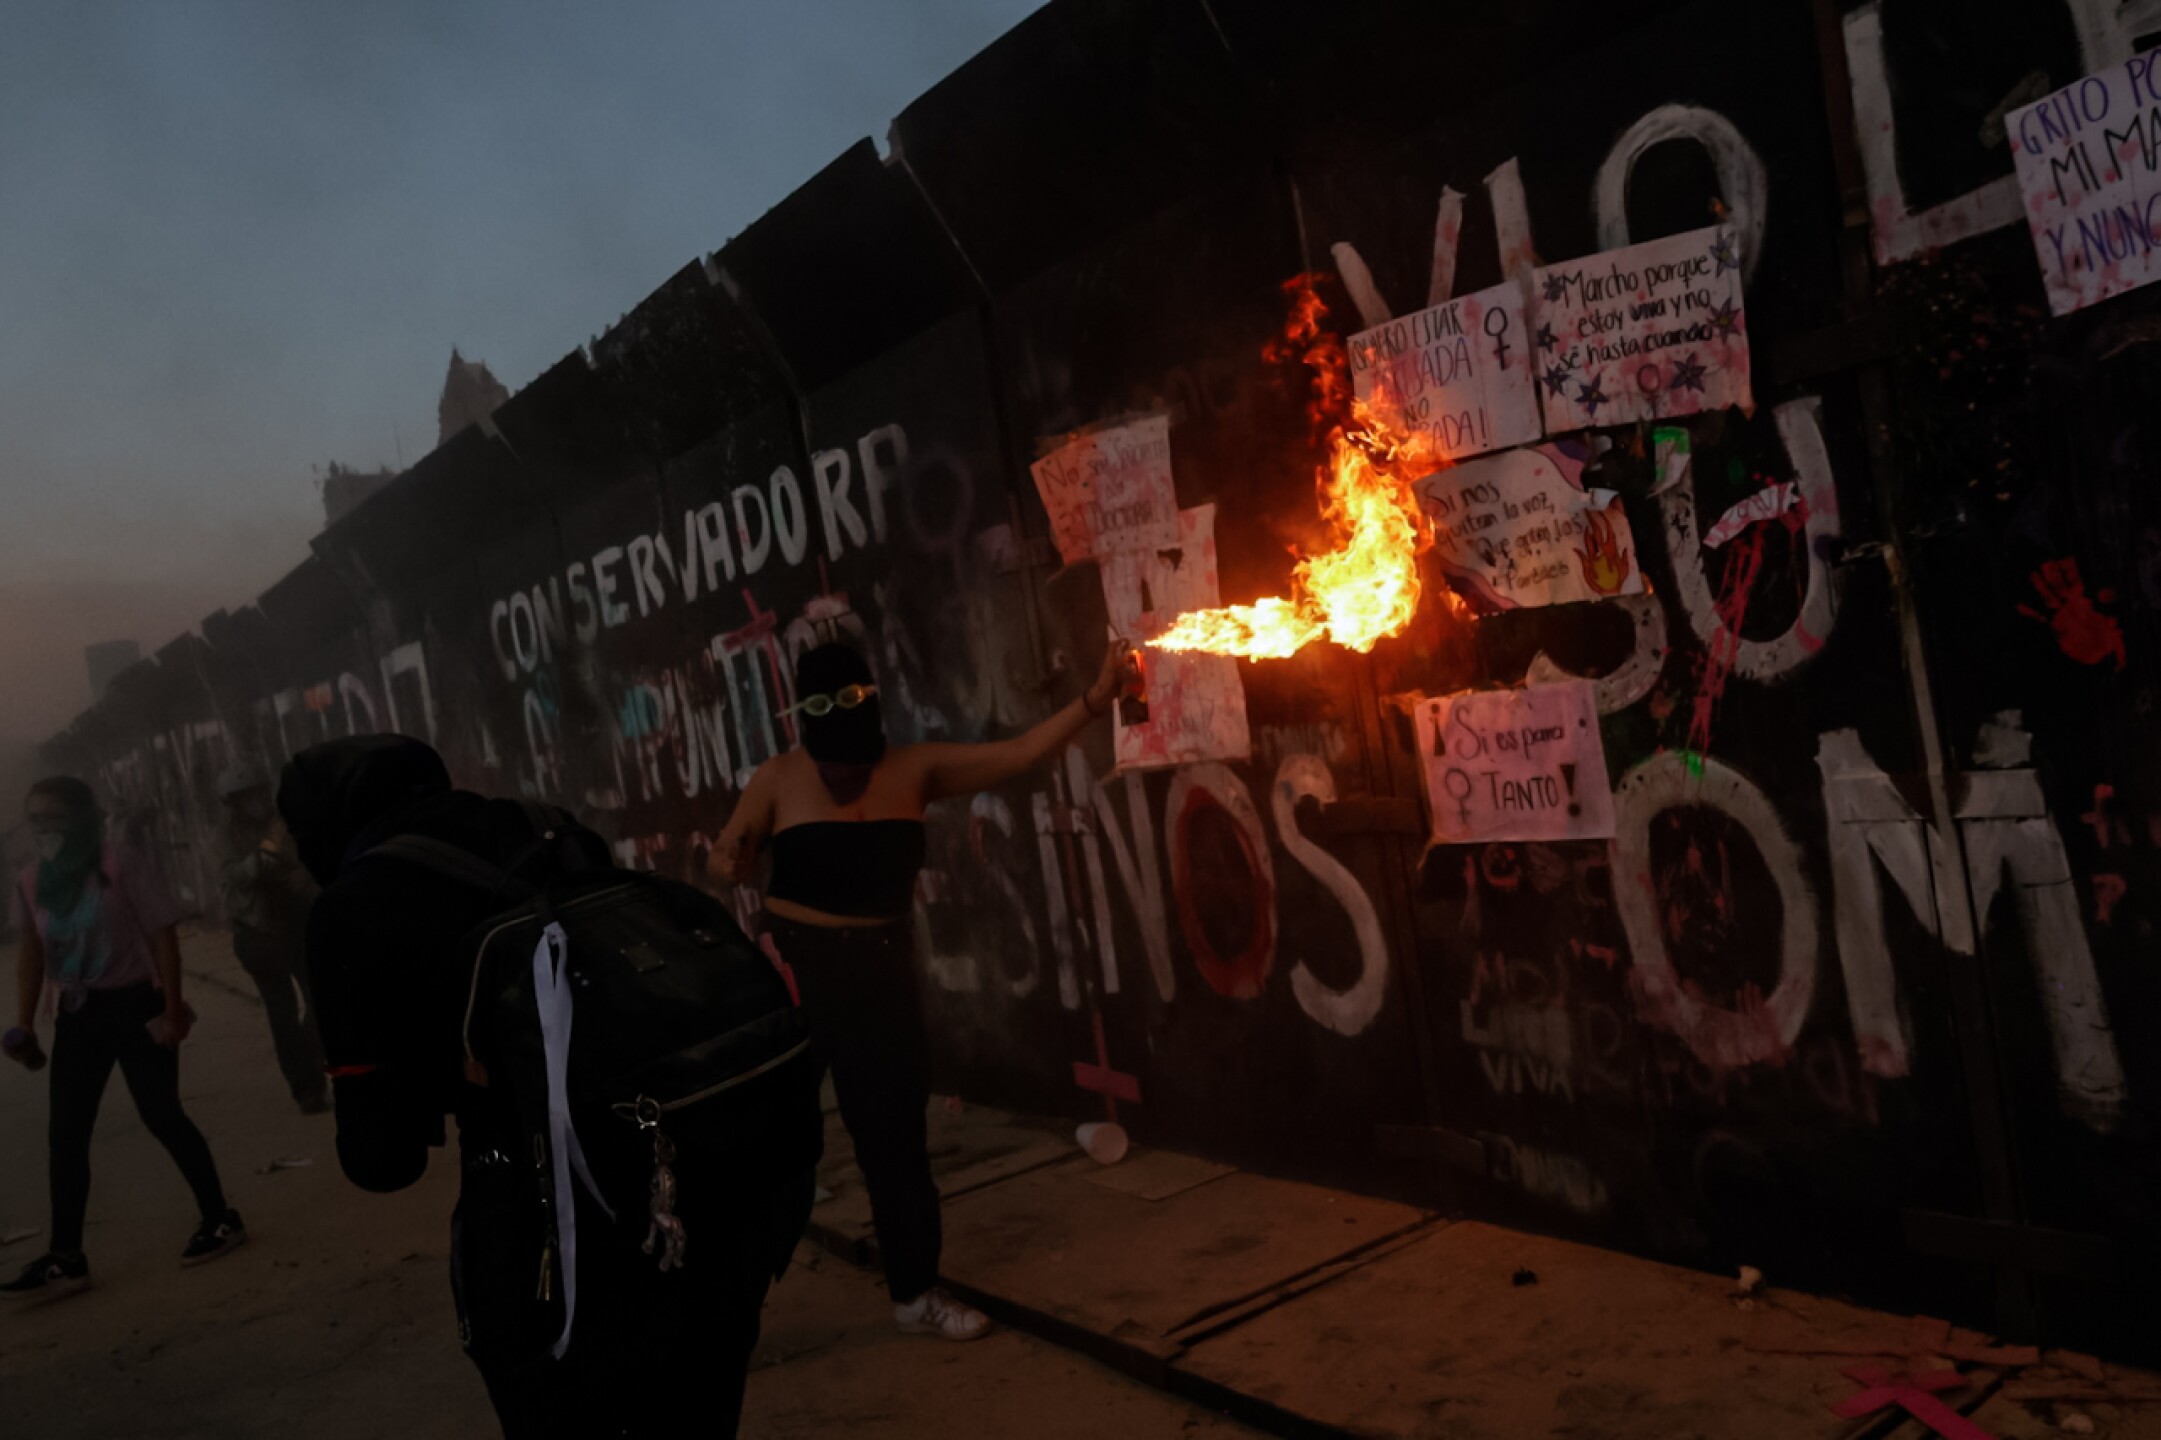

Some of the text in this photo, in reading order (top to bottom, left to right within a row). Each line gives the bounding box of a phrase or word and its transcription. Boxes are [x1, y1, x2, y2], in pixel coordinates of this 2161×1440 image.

[2020, 78, 2109, 154] GRITO
[2051, 142, 2100, 206] MI
[2047, 223, 2067, 279] Y
[1563, 255, 1711, 308] Marcho porque
[1578, 309, 1624, 338] estoy
[1686, 288, 1711, 309] no
[1587, 337, 1641, 364] hasta
[1644, 324, 1713, 353] cuando
[1462, 480, 1500, 507] nos
[1503, 501, 1519, 521] la
[1496, 732, 1518, 751] es
[1522, 726, 1566, 760] para
